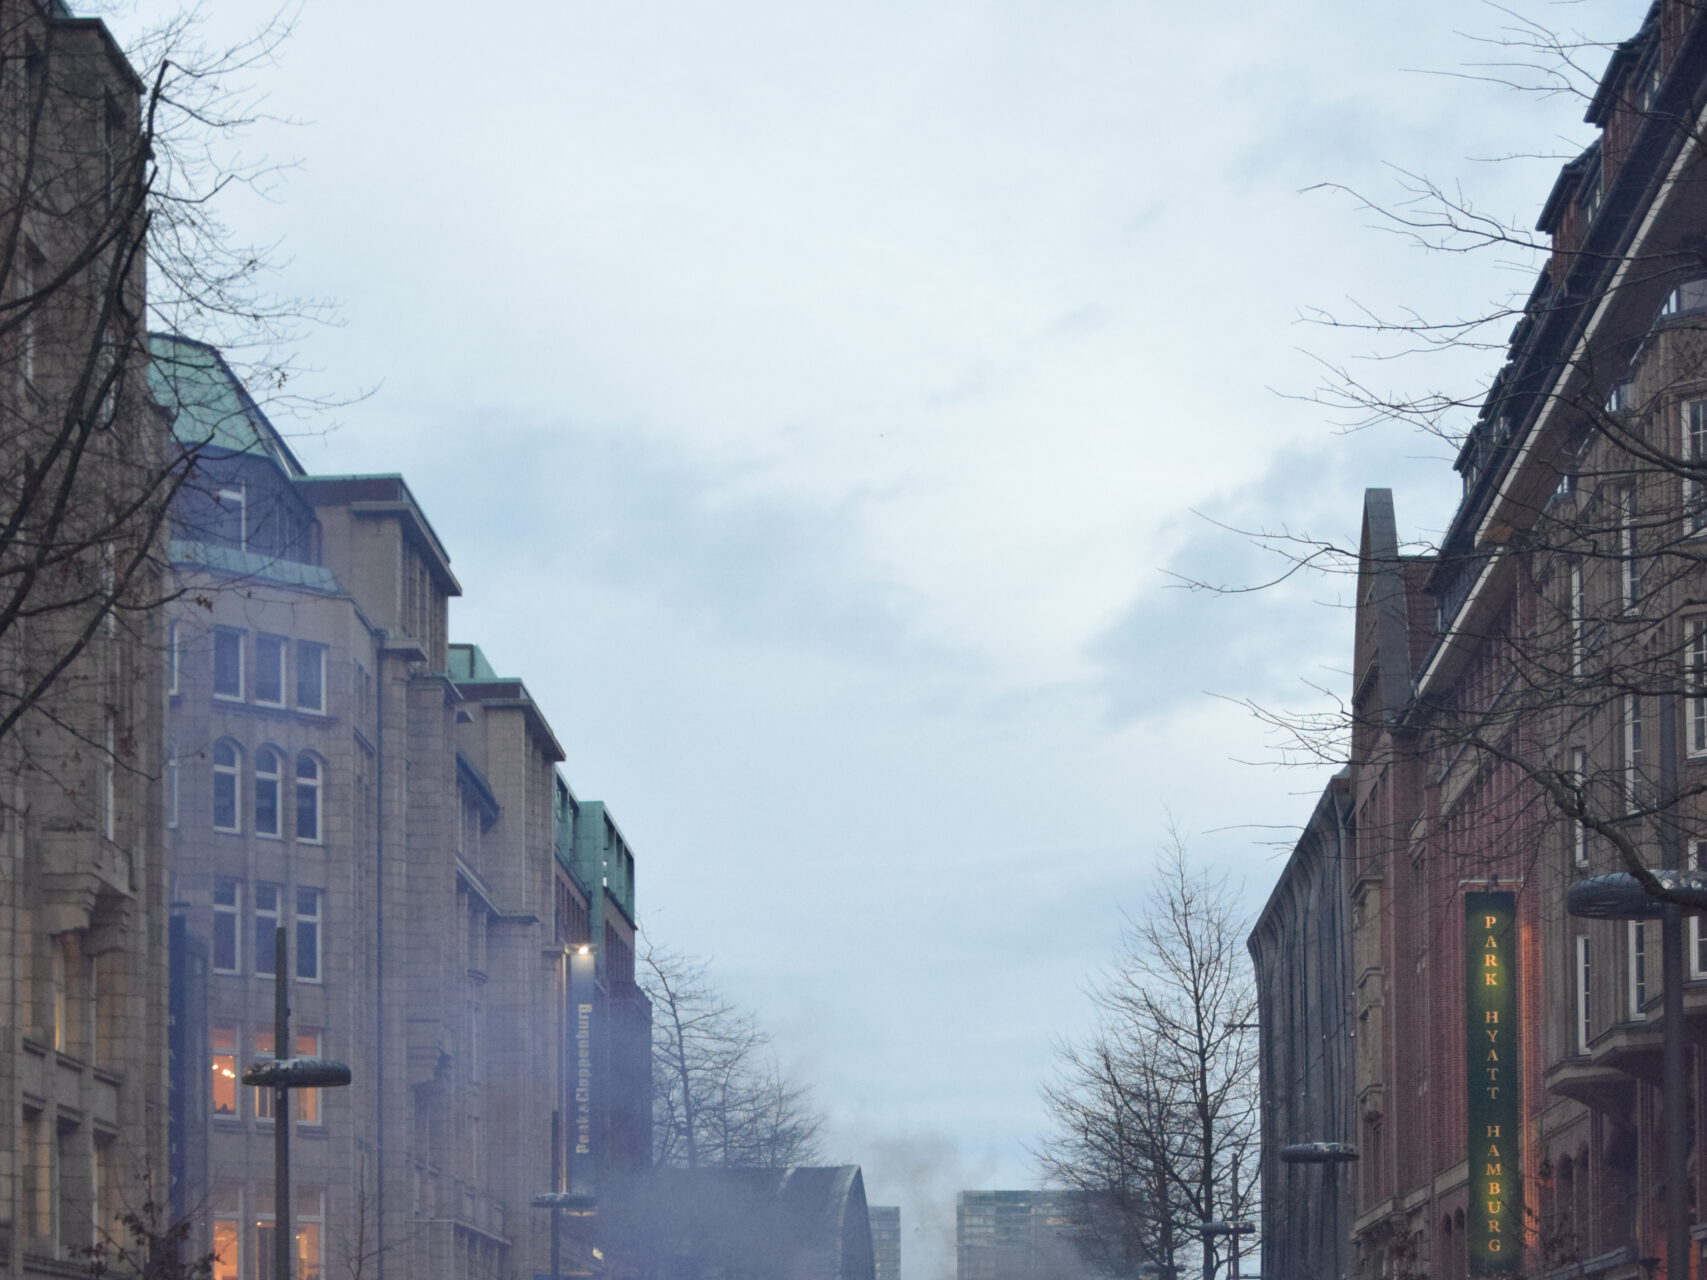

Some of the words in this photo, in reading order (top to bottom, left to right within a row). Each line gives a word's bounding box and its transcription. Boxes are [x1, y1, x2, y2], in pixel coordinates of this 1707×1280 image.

[1484, 915, 1497, 986] PARK
[1485, 1011, 1499, 1099] HYATT
[1486, 1125, 1502, 1252] HAMBURG
